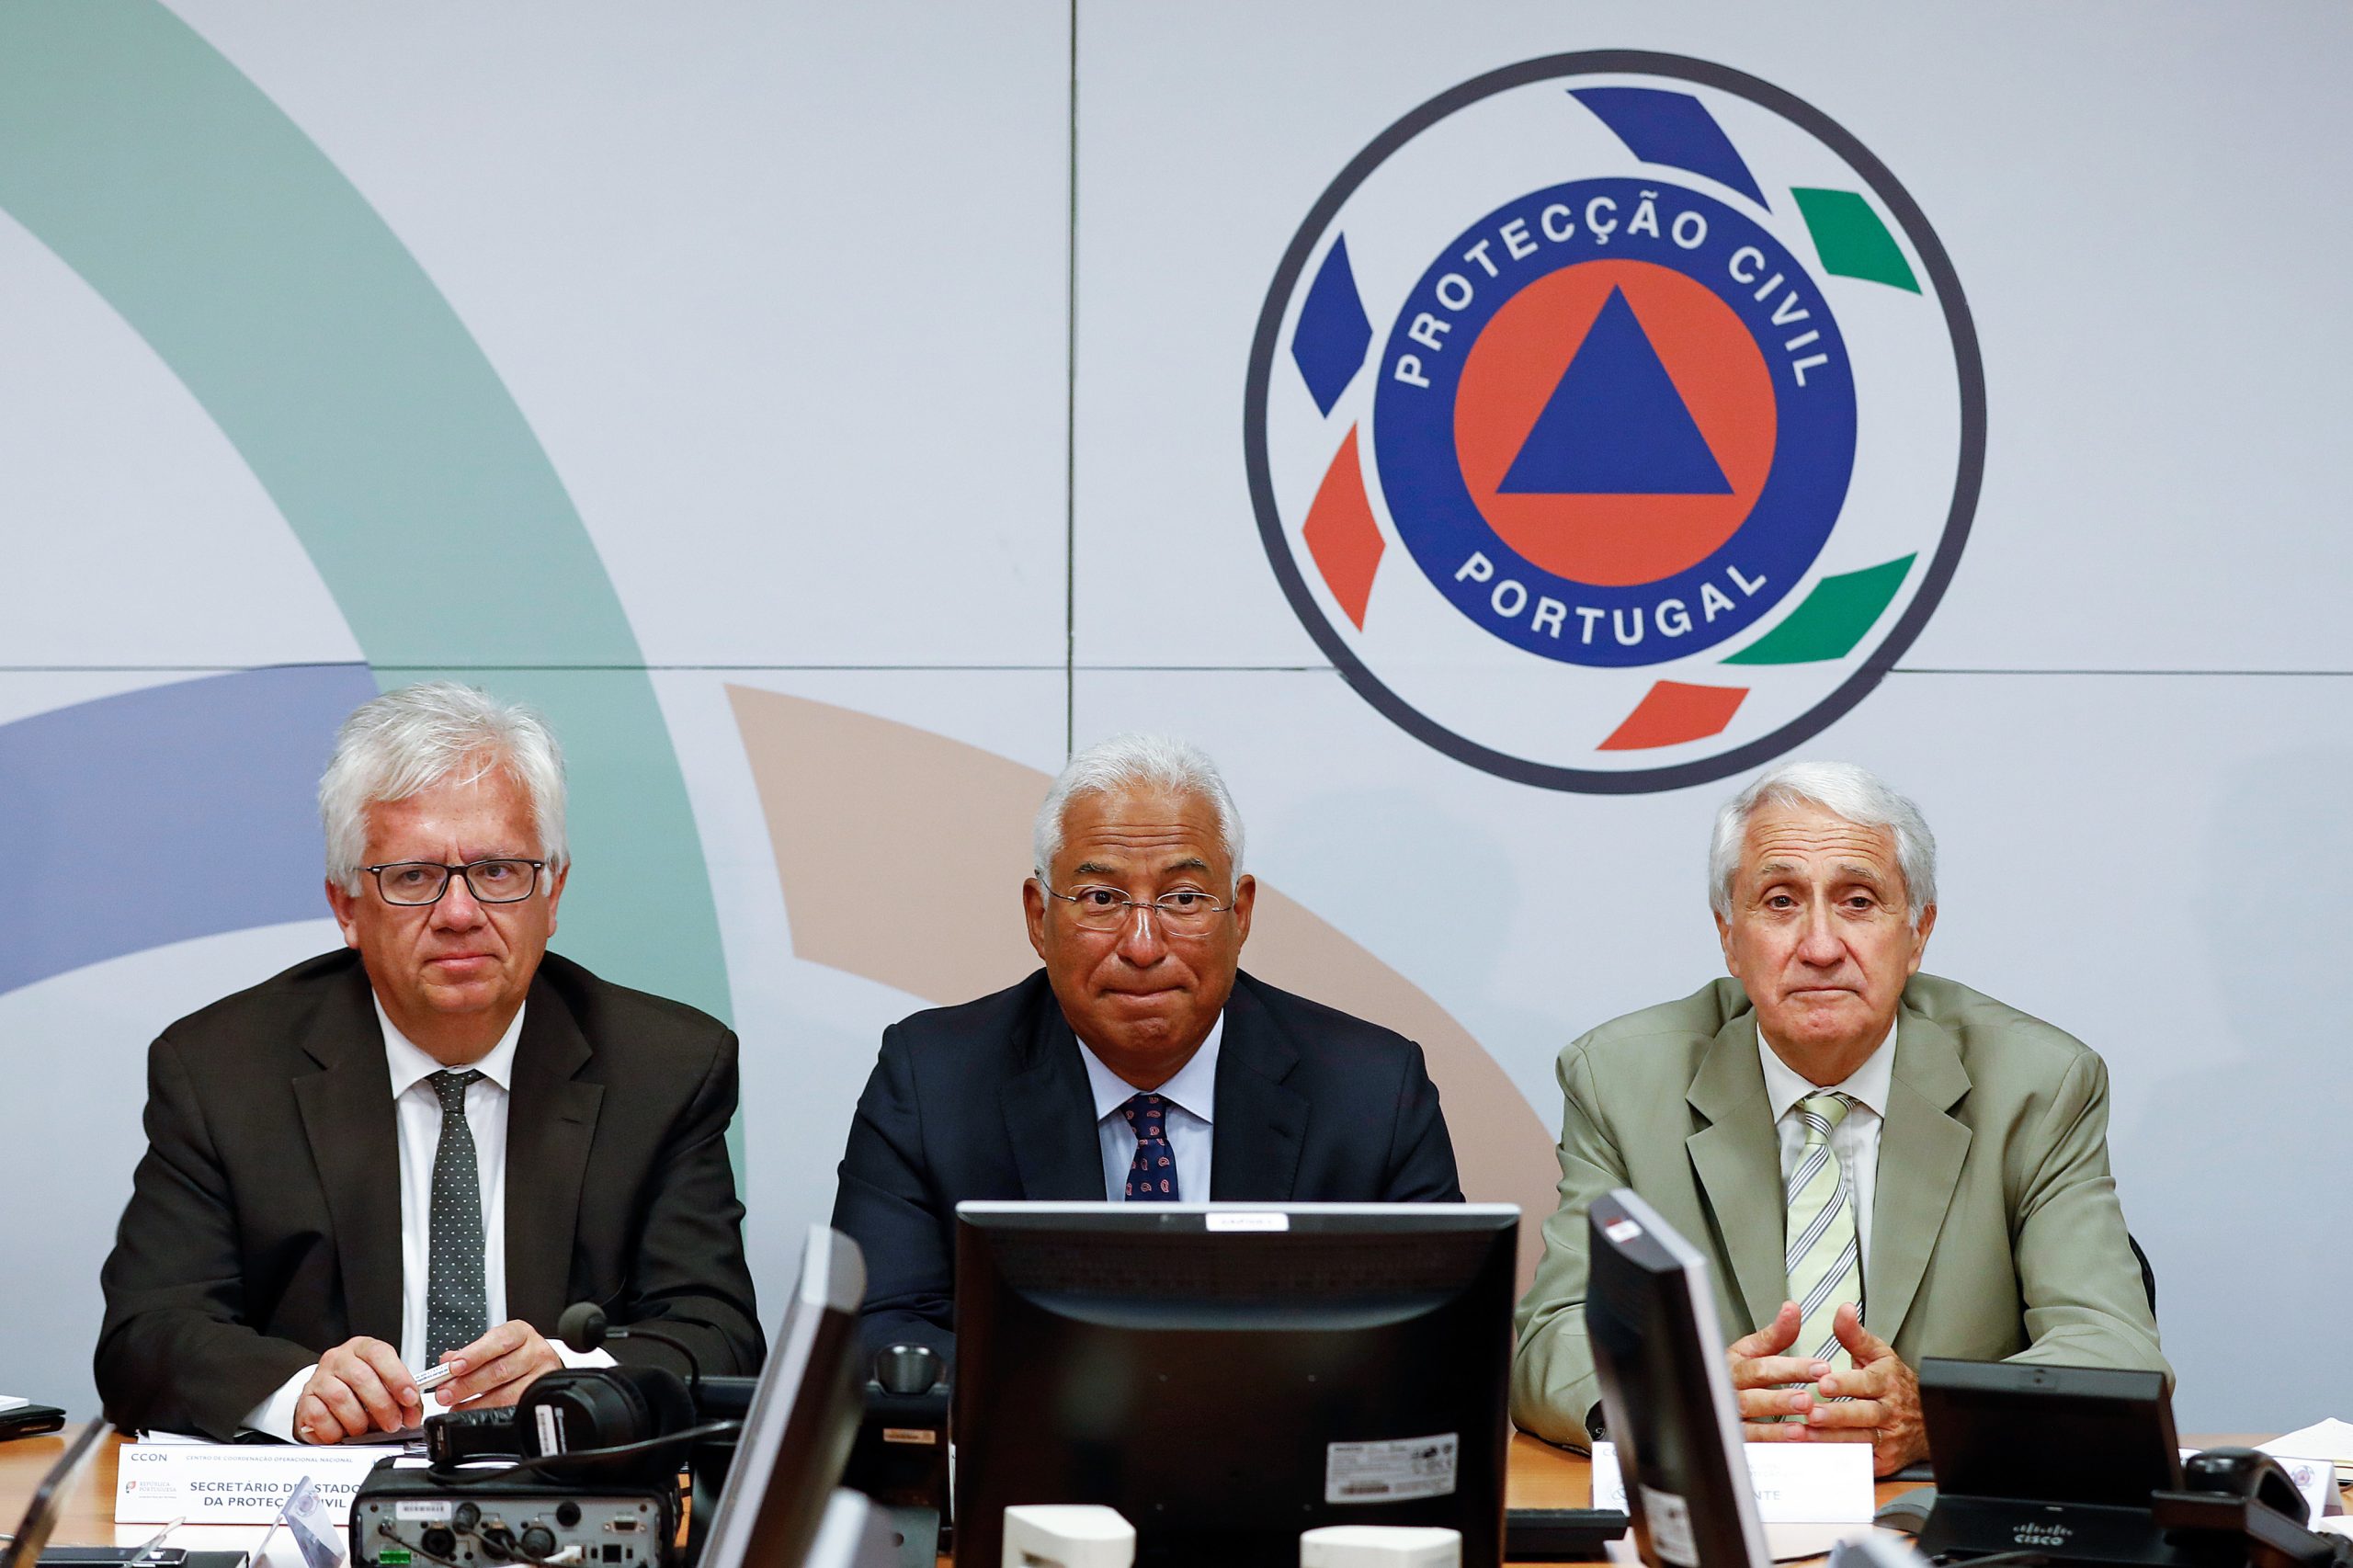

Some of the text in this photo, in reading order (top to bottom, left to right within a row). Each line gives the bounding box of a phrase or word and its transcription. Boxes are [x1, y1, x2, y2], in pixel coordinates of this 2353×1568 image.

[1394, 190, 1829, 388] PROTECÇÃO CIVIL
[1455, 551, 1767, 646] PORTUGAL
[131, 1453, 167, 1461] CCON
[223, 1455, 272, 1463] COORDENAÇÃO
[190, 1480, 278, 1493] SECRETÁRIO
[314, 1483, 361, 1494] STADO
[203, 1497, 223, 1506] DA
[228, 1496, 292, 1509] PROTEÇ
[2014, 1533, 2064, 1545] cisco
